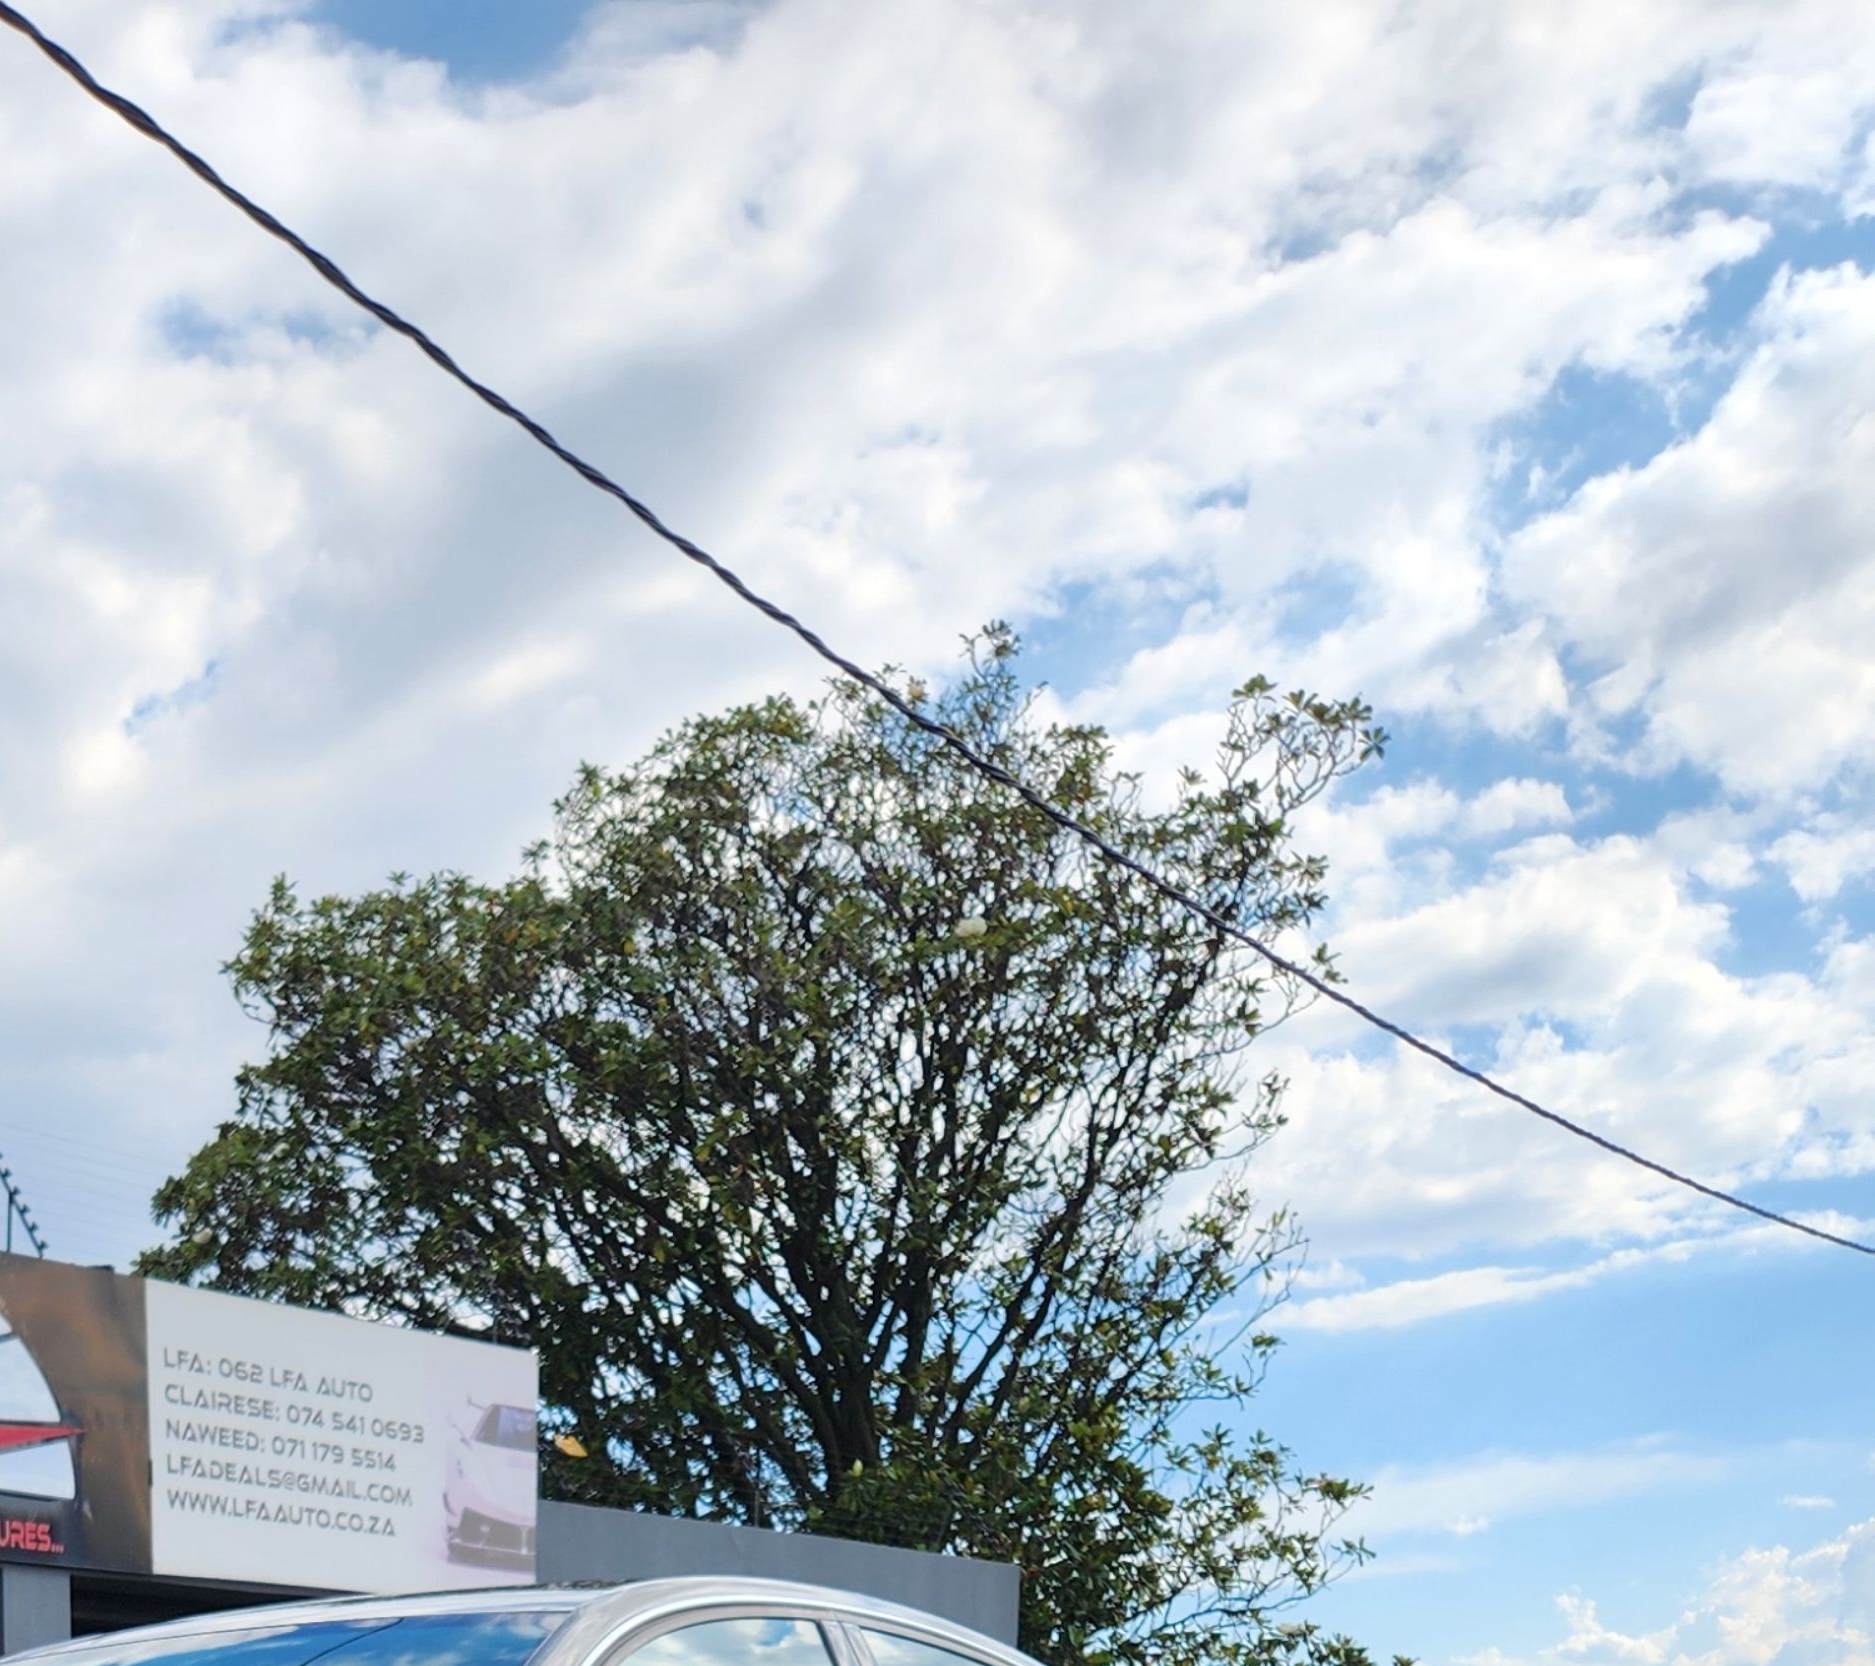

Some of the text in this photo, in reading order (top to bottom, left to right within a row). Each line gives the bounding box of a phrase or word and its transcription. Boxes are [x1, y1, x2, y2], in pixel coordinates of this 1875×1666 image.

[163, 1347, 374, 1403] LFA: 062 LFA AUTO
[165, 1384, 426, 1445] CLAIRESE: 074 541 0693
[166, 1419, 397, 1472] NAWEED: 071 179 5514
[167, 1454, 413, 1508] LFADEALS@GMAIL.COM
[167, 1489, 397, 1537] WWW.LFAAUTO.CO.ZA
